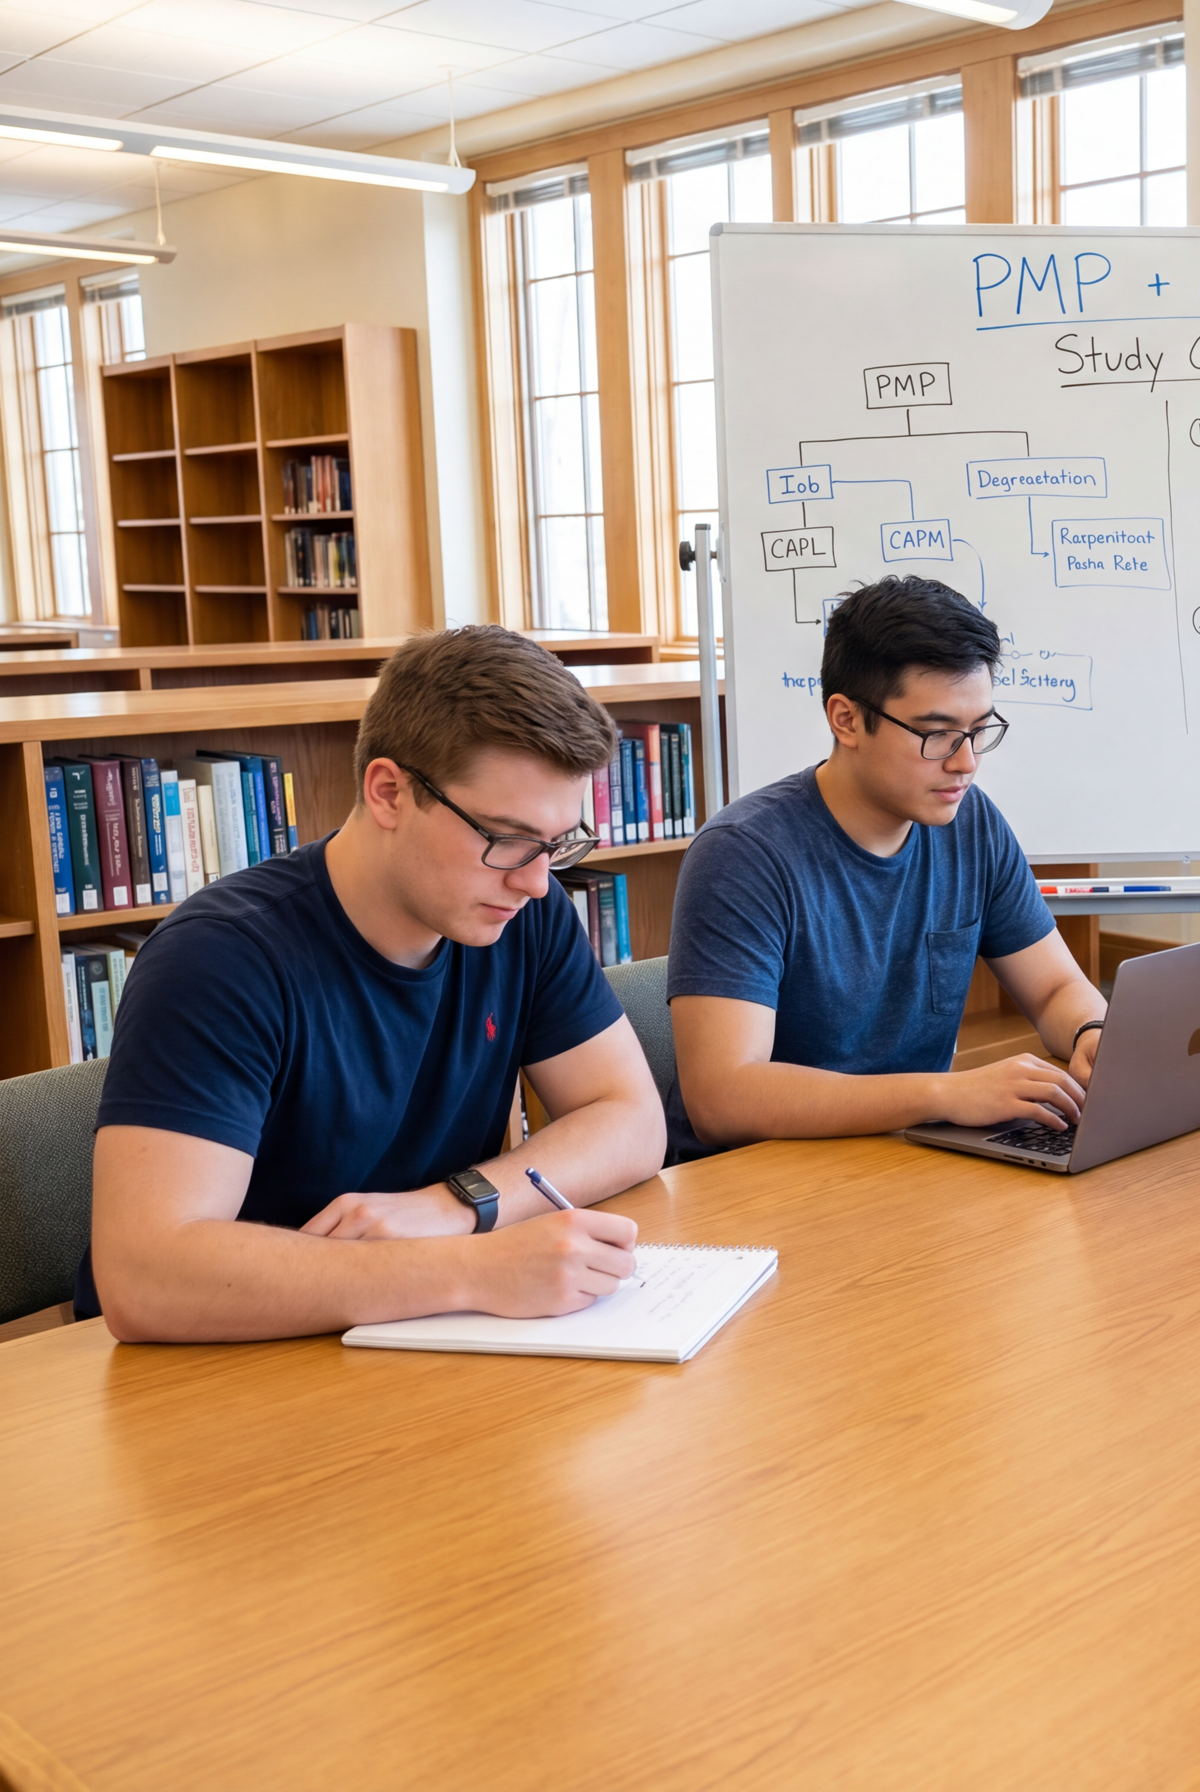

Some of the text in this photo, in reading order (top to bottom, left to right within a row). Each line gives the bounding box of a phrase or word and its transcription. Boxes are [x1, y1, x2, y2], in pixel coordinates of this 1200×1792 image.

[973, 252, 1112, 318] PMP
[1148, 273, 1171, 297] +
[1055, 333, 1164, 393] Study
[876, 371, 936, 399] PMP
[770, 537, 827, 559] CAPL
[889, 529, 946, 551] CAPM
